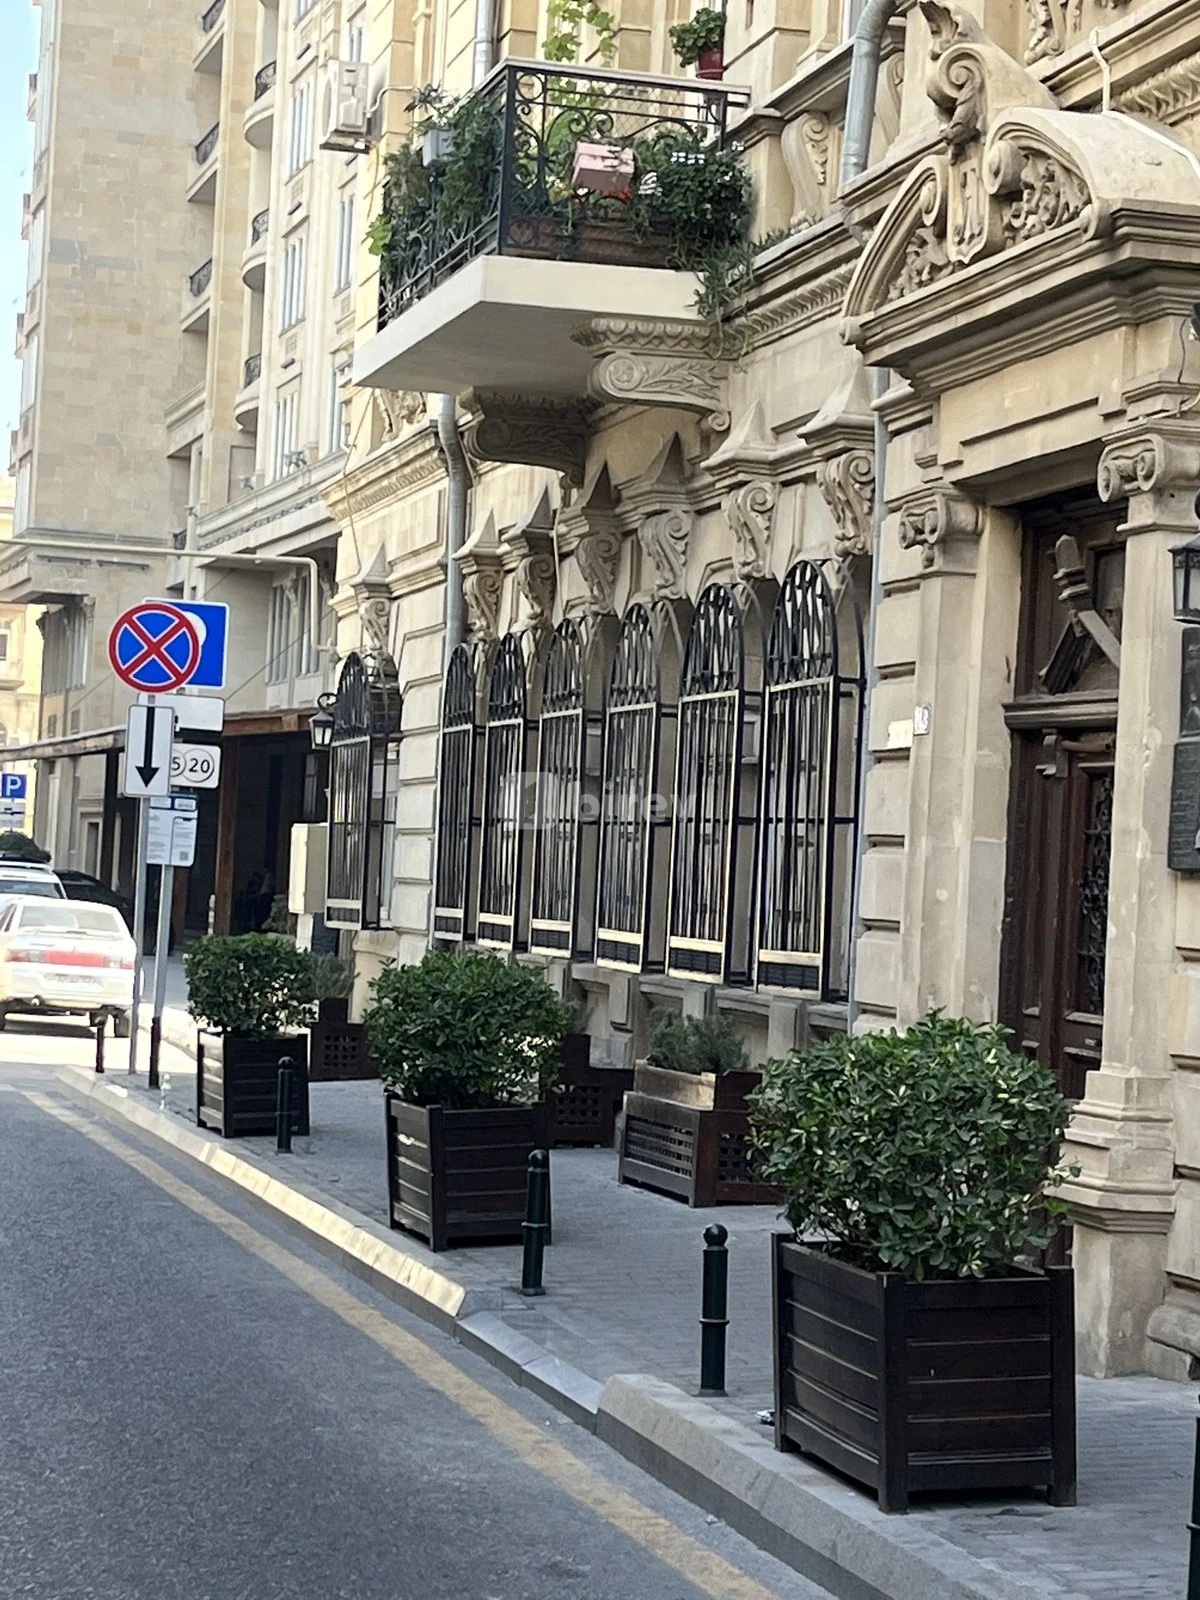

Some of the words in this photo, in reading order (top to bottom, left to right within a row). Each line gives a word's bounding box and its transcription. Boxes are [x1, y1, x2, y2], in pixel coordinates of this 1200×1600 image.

[172, 757, 181, 771] 5
[188, 758, 211, 774] 20
[6, 776, 22, 797] P
